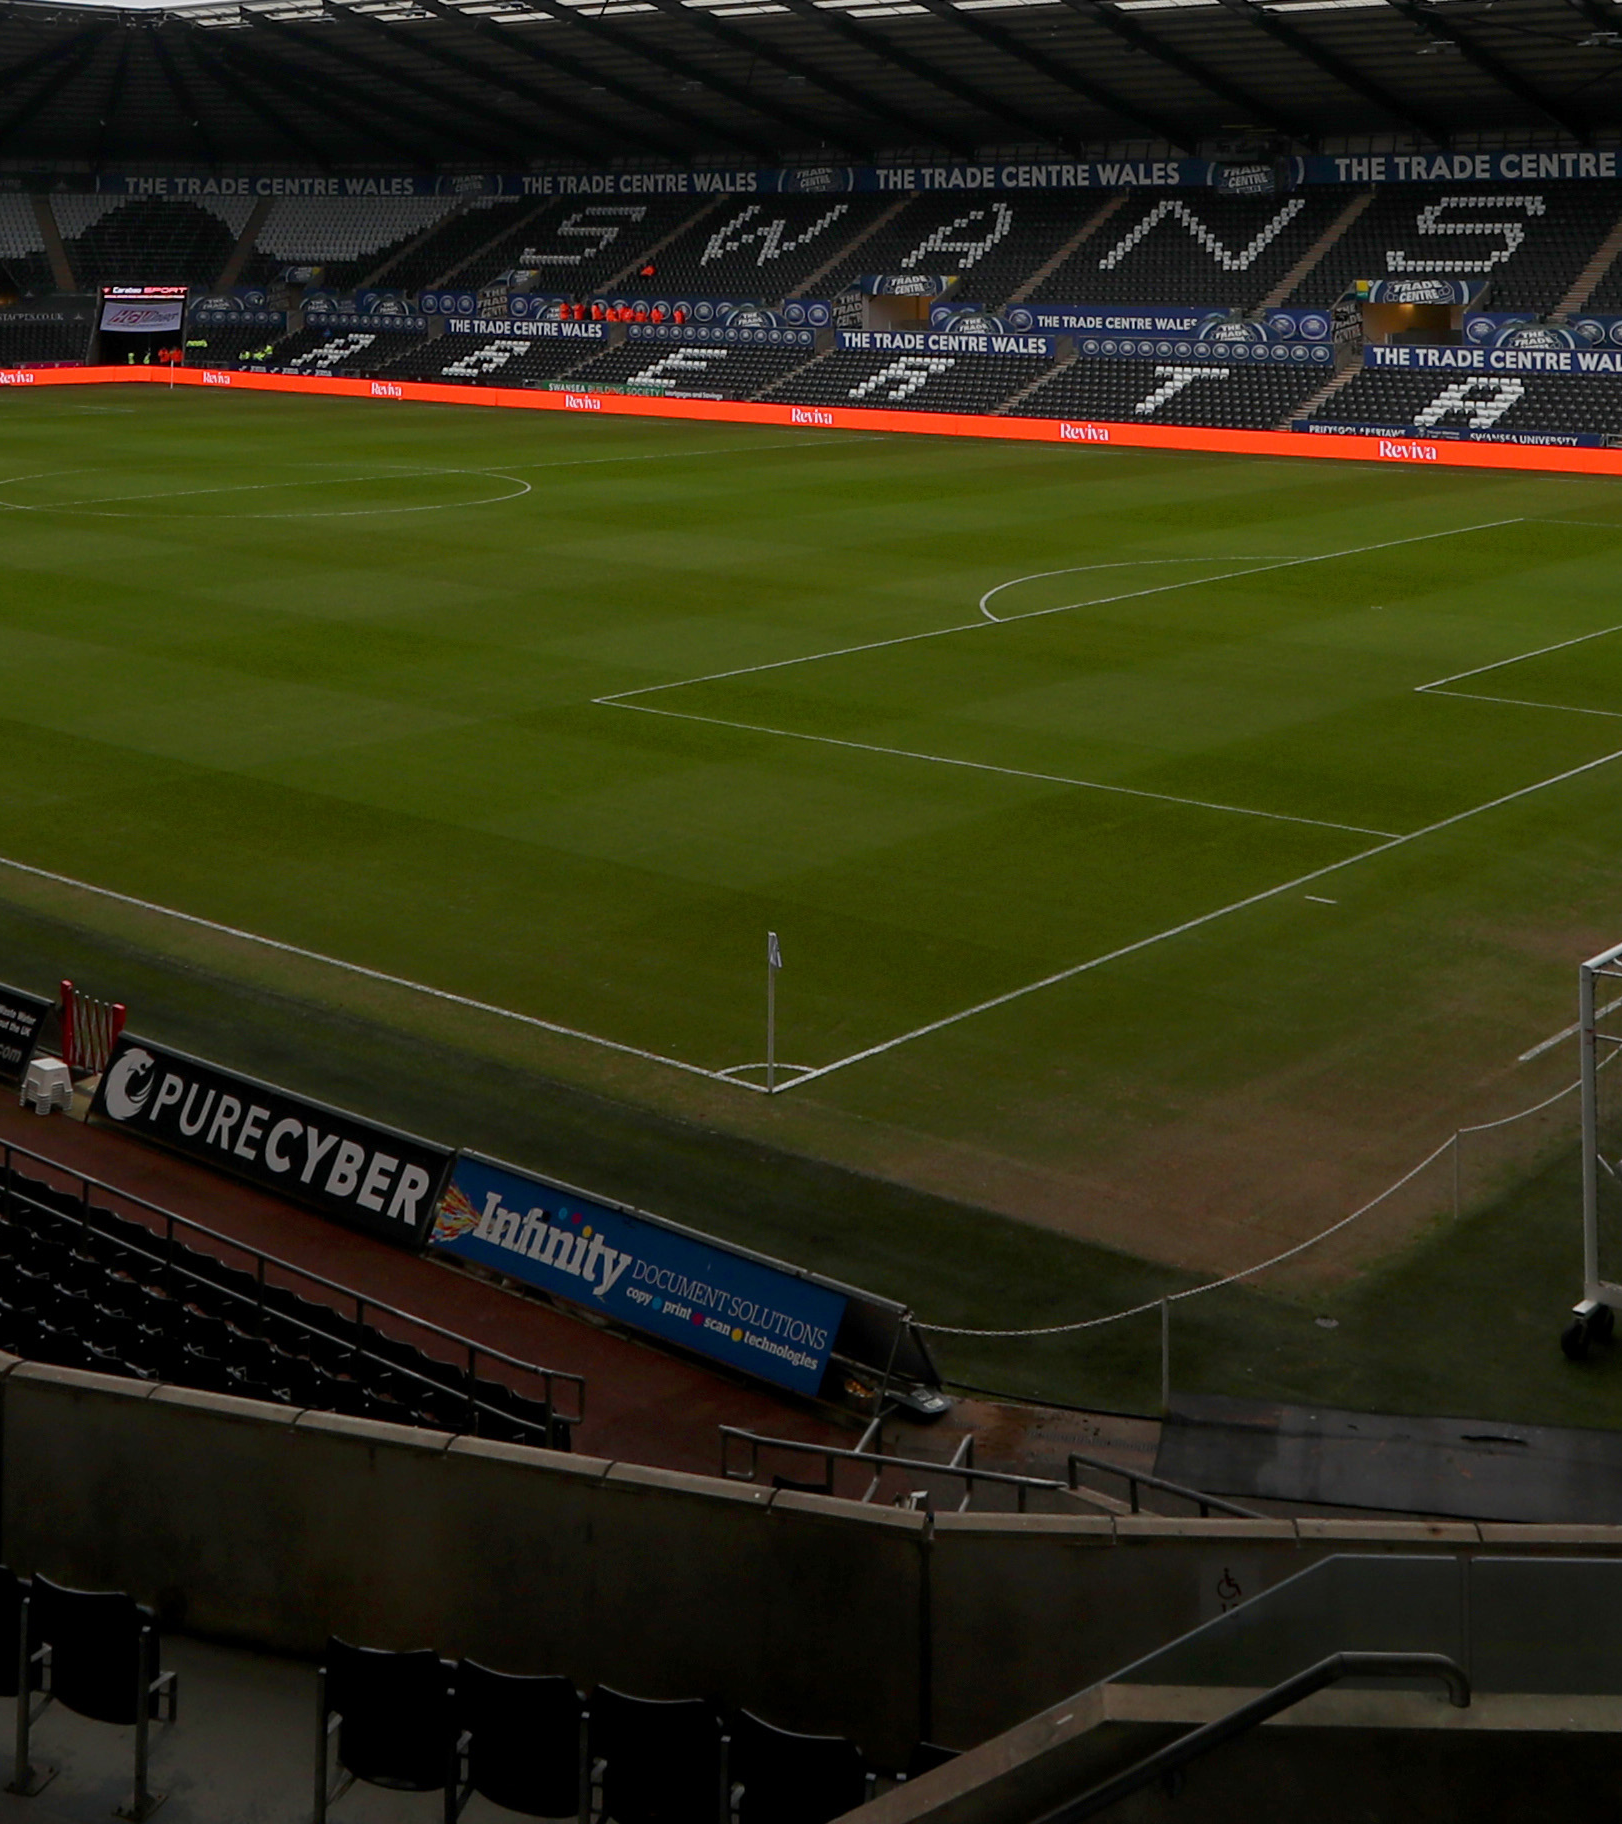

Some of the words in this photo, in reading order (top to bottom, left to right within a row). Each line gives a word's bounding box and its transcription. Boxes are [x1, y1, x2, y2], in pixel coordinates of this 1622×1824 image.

[1335, 158, 1386, 181] THE
[1394, 155, 1497, 180] TRADE
[1505, 151, 1619, 178] CENTRE
[522, 176, 553, 194] THE
[557, 175, 615, 194] TRADE
[620, 174, 688, 194] CENTRE
[693, 172, 757, 193] WALES
[876, 169, 915, 190] THE
[920, 167, 995, 189] TRADE
[1001, 164, 1090, 188] CENTRE
[1096, 162, 1179, 186] WALES
[1228, 174, 1268, 188] CENTRE
[125, 177, 167, 194] THE
[175, 176, 250, 195] TRADE
[256, 176, 339, 195] CENTRE
[344, 177, 415, 194] WALES
[1394, 280, 1443, 293] TRADE
[840, 292, 862, 303] THE
[1399, 289, 1439, 303] CENTRE
[450, 319, 470, 333] THE
[472, 320, 511, 334] TRADE
[514, 321, 559, 336] CENTRE
[562, 323, 603, 338] WALES
[1037, 315, 1059, 328] THE
[1062, 316, 1103, 329] TRADE
[1105, 317, 1154, 330] CENTRE
[1157, 318, 1197, 331] WALES
[843, 332, 869, 349] THE
[874, 333, 924, 350] TRADE
[928, 334, 987, 353] CENTRE
[992, 336, 1047, 355] WALES
[1373, 347, 1418, 366] THE
[1423, 348, 1485, 368] TRADE
[1490, 349, 1571, 371] CENTRE
[203, 372, 230, 385] Reviva
[371, 382, 402, 397] Reviva
[549, 382, 587, 393] SWANSEA
[588, 385, 624, 395] BUILDING
[626, 386, 661, 397] SOCIETY
[565, 394, 601, 410] Reviva
[790, 408, 833, 425] Reviva
[1060, 423, 1109, 441] Reviva
[1519, 434, 1578, 447] UNIVERSITY
[1379, 440, 1437, 461] Reviva
[148, 1072, 430, 1227] PURECYBER
[473, 1191, 633, 1297] Infinity
[632, 1258, 730, 1314] DOCUMENT
[729, 1296, 828, 1351] SOLUTIONS
[626, 1285, 653, 1308] copy
[662, 1299, 692, 1322] print
[703, 1316, 731, 1337] scan
[742, 1329, 819, 1371] technologies
